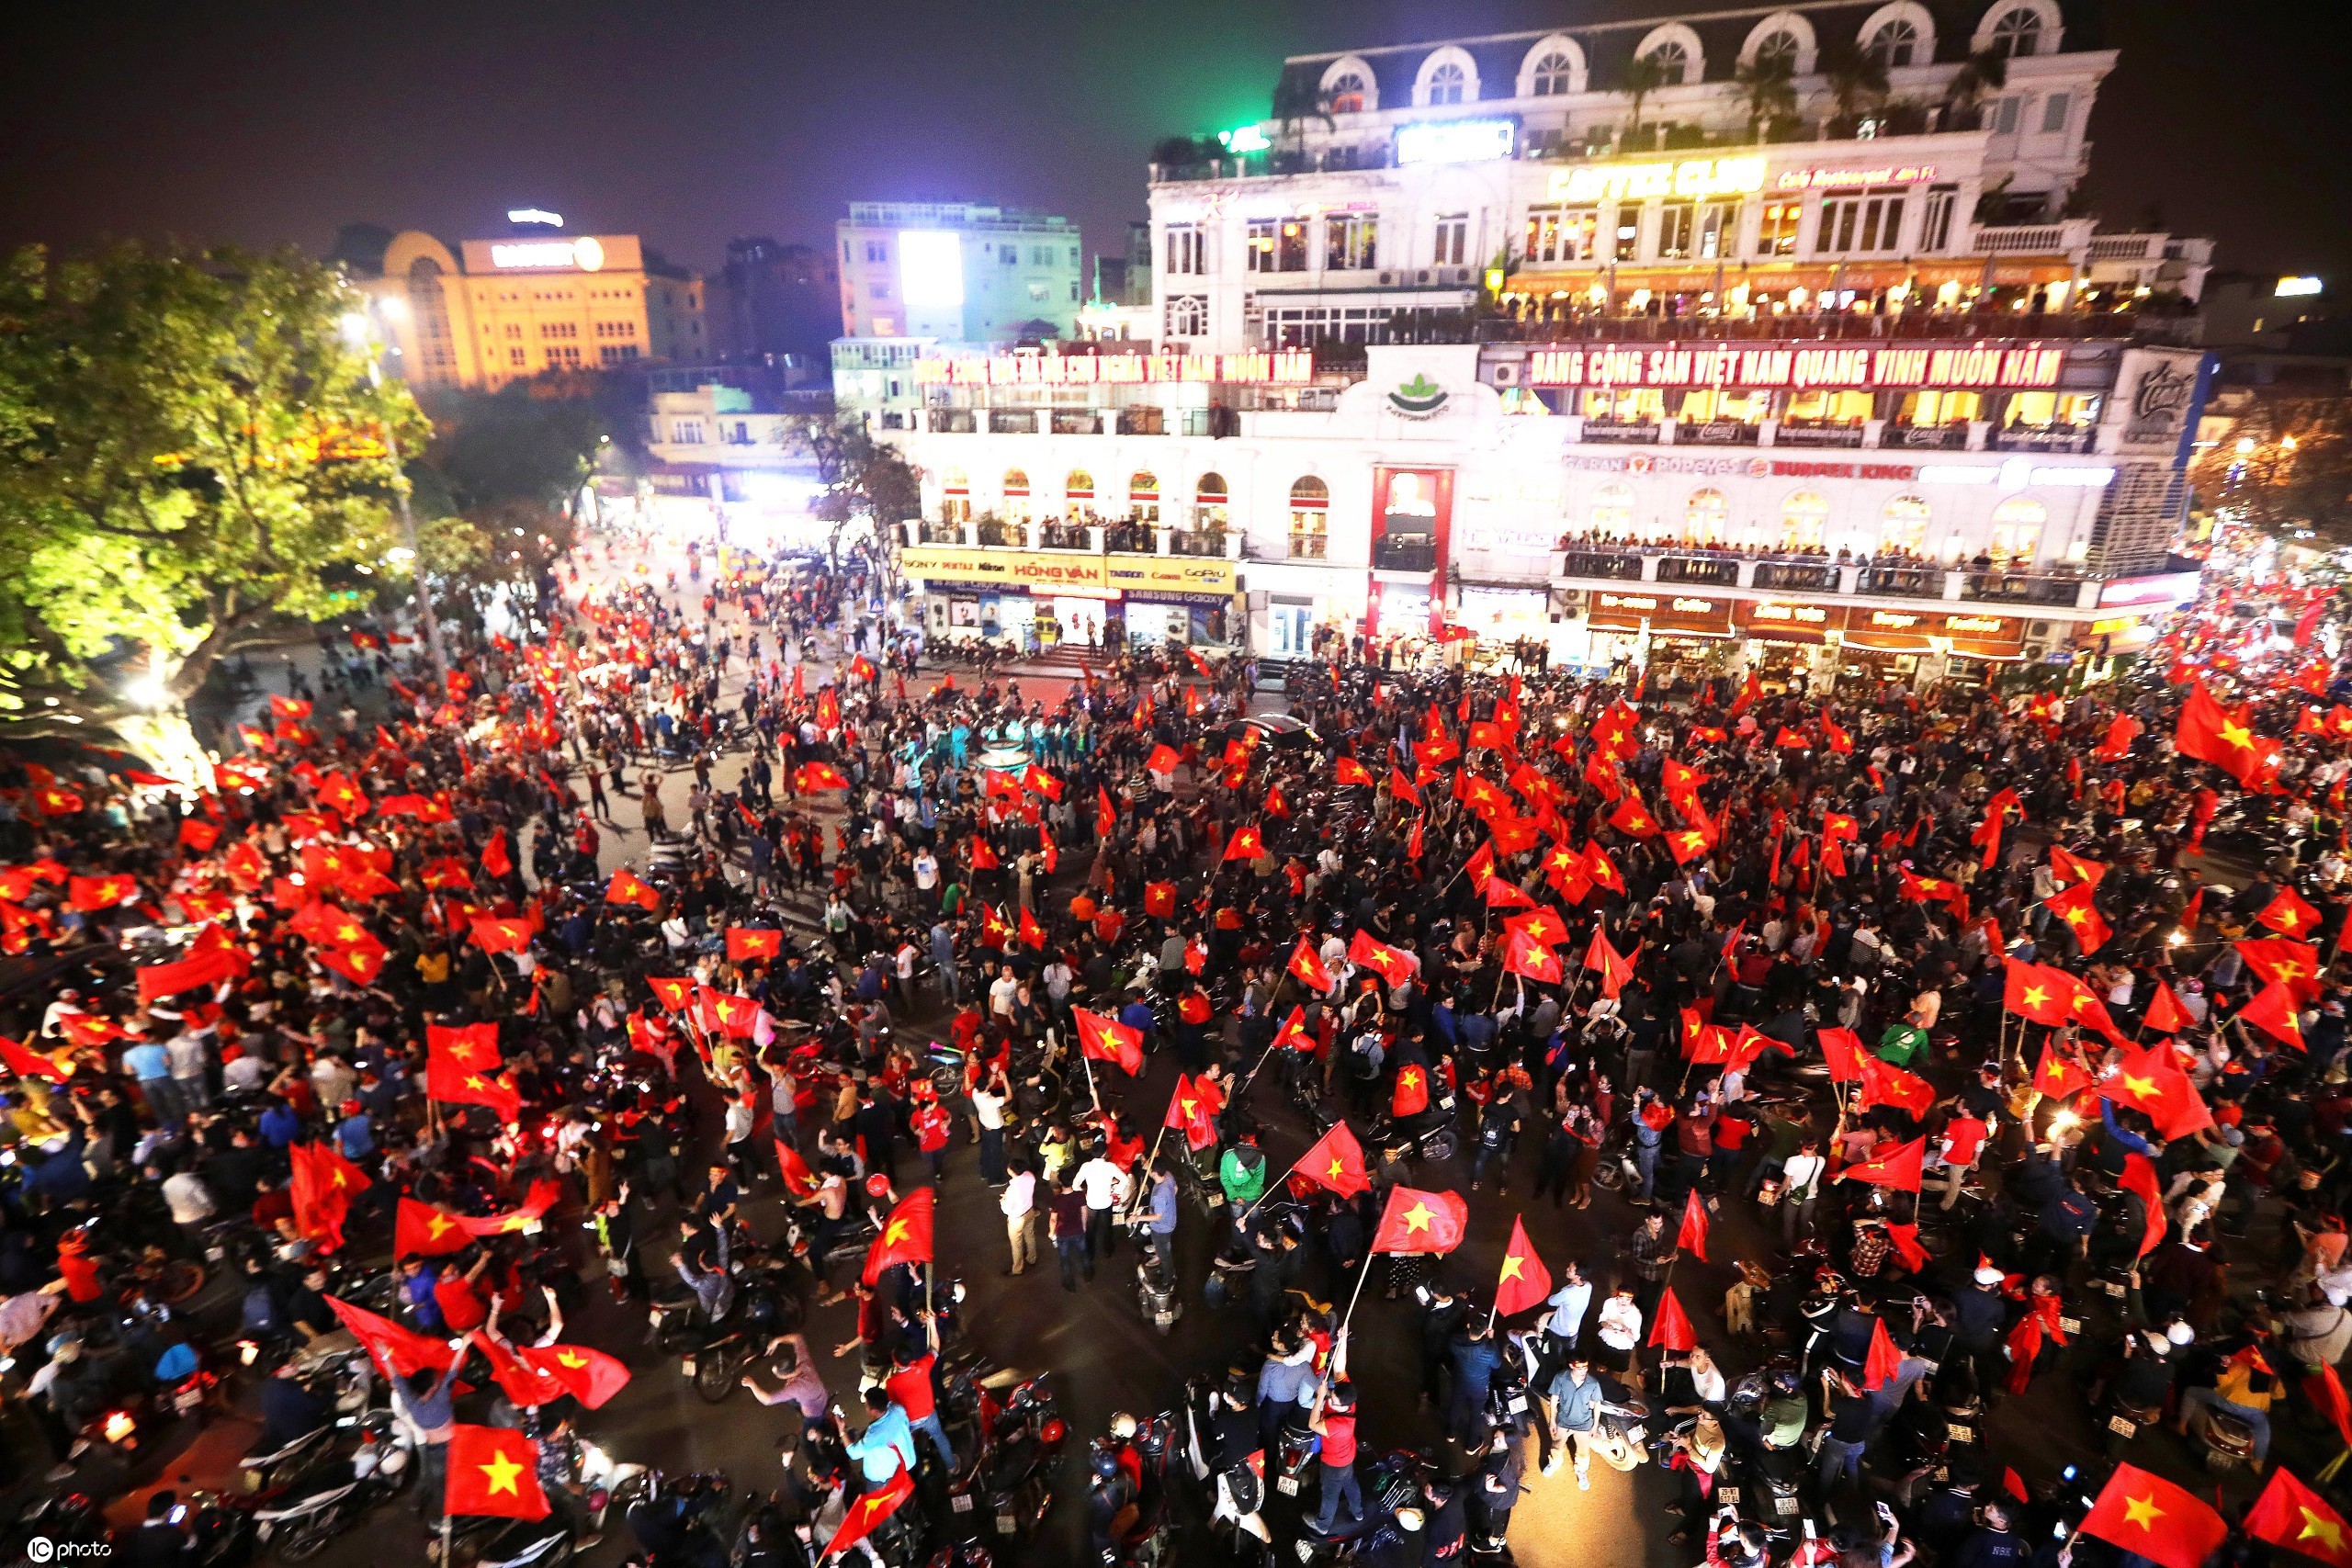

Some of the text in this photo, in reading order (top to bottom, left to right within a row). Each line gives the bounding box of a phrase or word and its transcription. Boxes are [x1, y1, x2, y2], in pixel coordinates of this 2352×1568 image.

[1148, 346, 1181, 382] VIỆT
[1182, 354, 1216, 382] NAM
[1222, 346, 1271, 382] MUÔN
[1274, 345, 1312, 382] NĂM
[1589, 343, 1643, 389] CỘNG
[1648, 341, 1692, 384] SẢN
[1694, 343, 1740, 389] VIỆT
[1741, 350, 1792, 384] NAM
[1793, 350, 1869, 389] QUANG
[1872, 349, 1928, 386] VINH
[1928, 341, 2003, 386] MUÔN
[2000, 341, 2064, 387] NĂM
[1771, 462, 1852, 478] BURGER
[1860, 464, 1914, 479] KING
[942, 561, 974, 570] PENTAX
[978, 562, 1005, 571] Nikon
[1013, 562, 1099, 579] HỒNG VÂN
[1185, 568, 1227, 578] GoPro
[1151, 570, 1182, 581] Canon
[1128, 589, 1182, 602] SAMSUNG
[1183, 592, 1225, 606] Galaxy
[1673, 597, 1713, 613] Coffee
[1872, 611, 1917, 629] Burger
